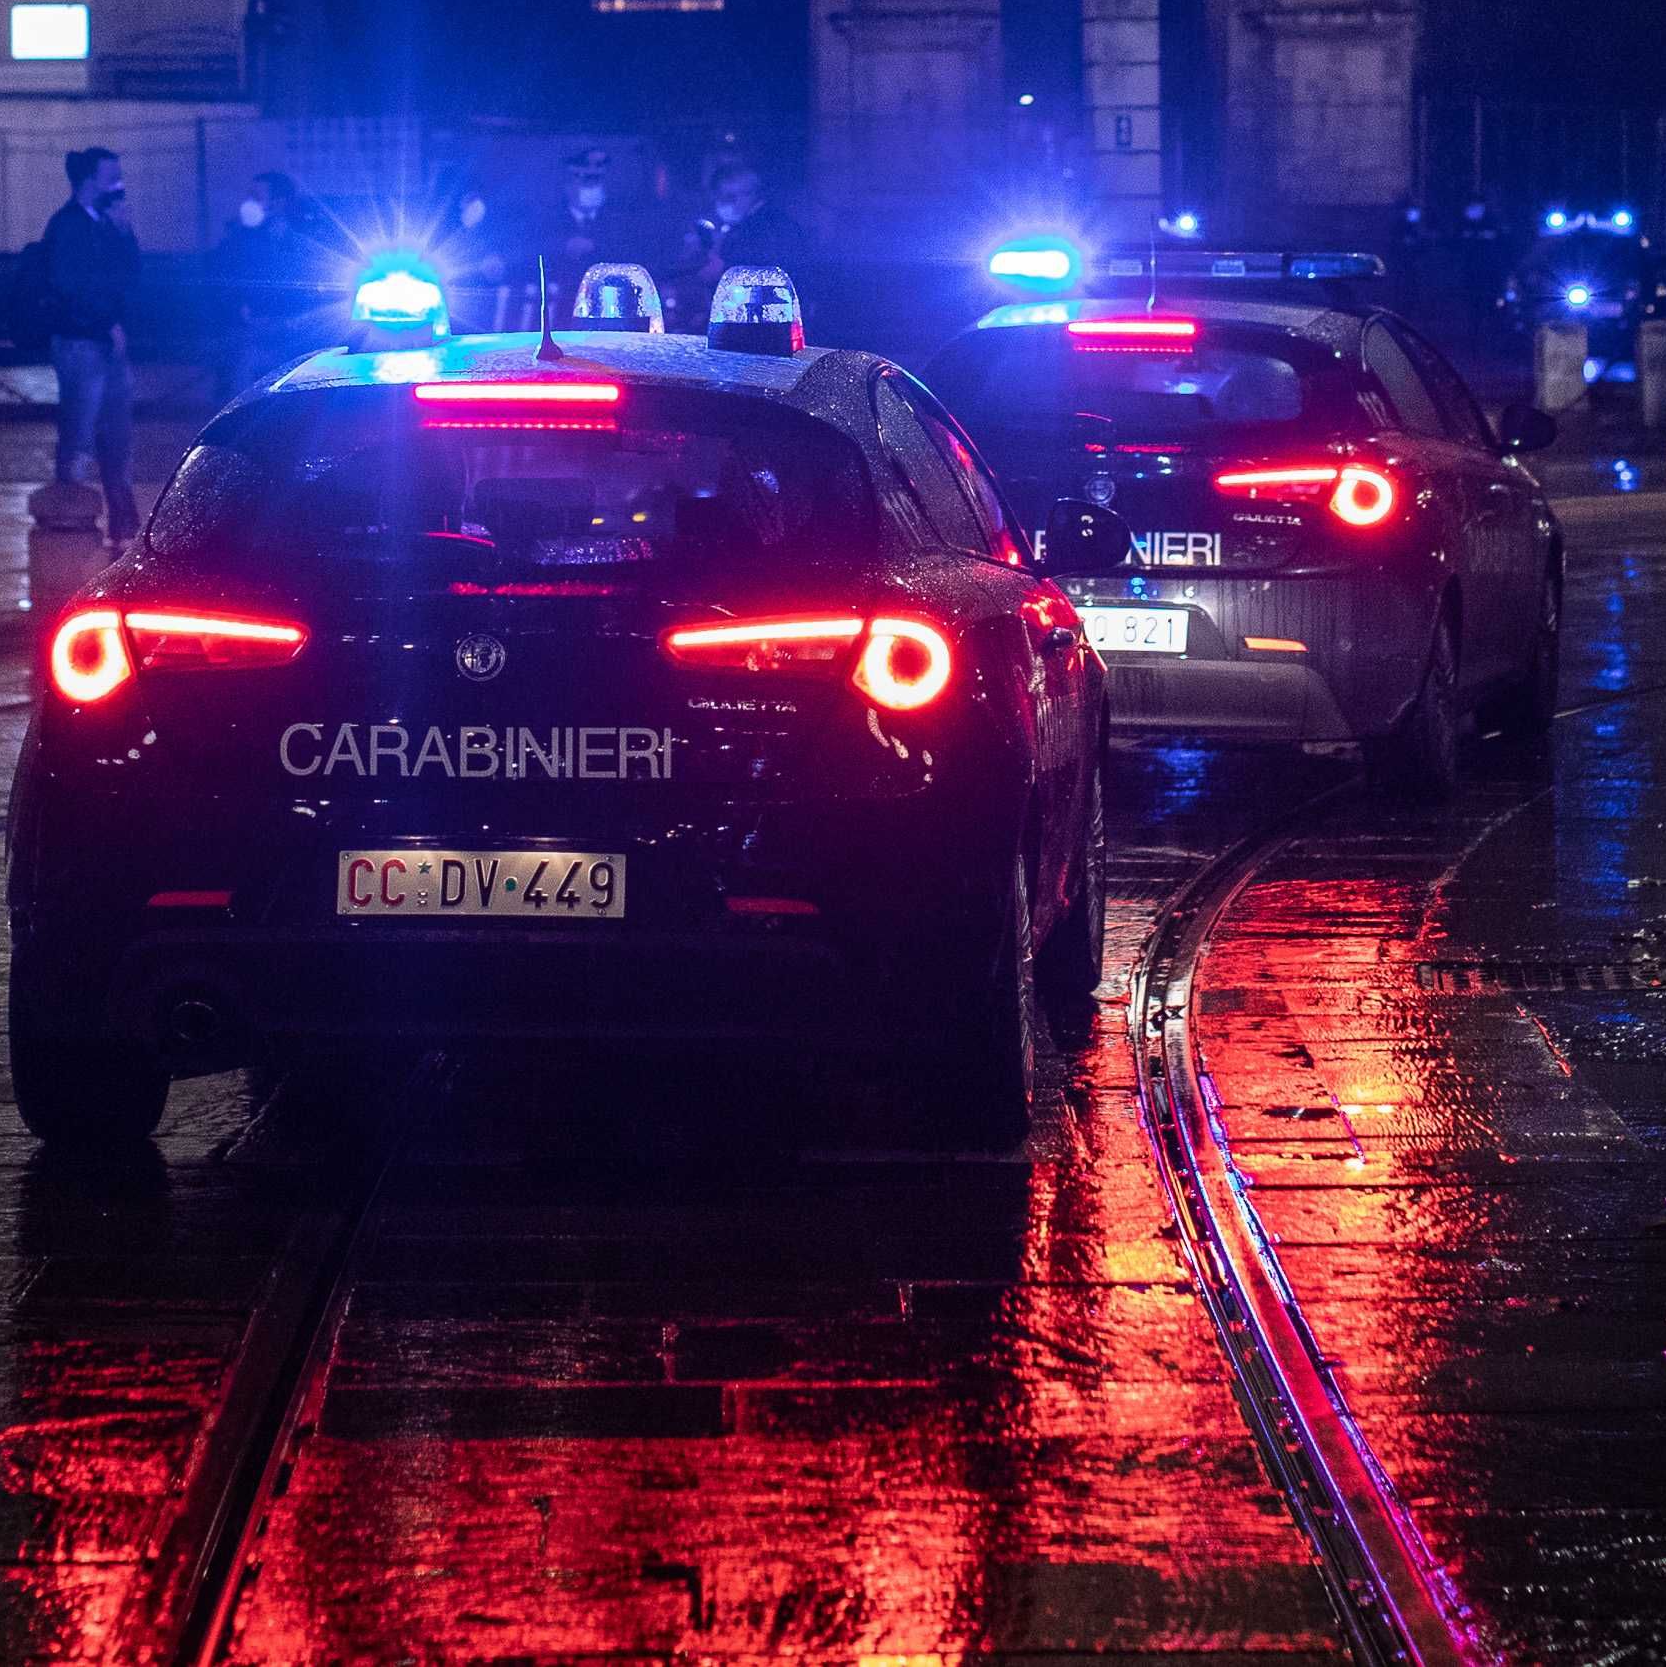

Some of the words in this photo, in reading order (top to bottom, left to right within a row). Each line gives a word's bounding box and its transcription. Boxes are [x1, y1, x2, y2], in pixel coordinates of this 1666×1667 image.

[279, 722, 673, 779] CARABINIERI
[348, 859, 406, 907] CC
[440, 859, 499, 907] DV
[523, 860, 614, 909] 449
